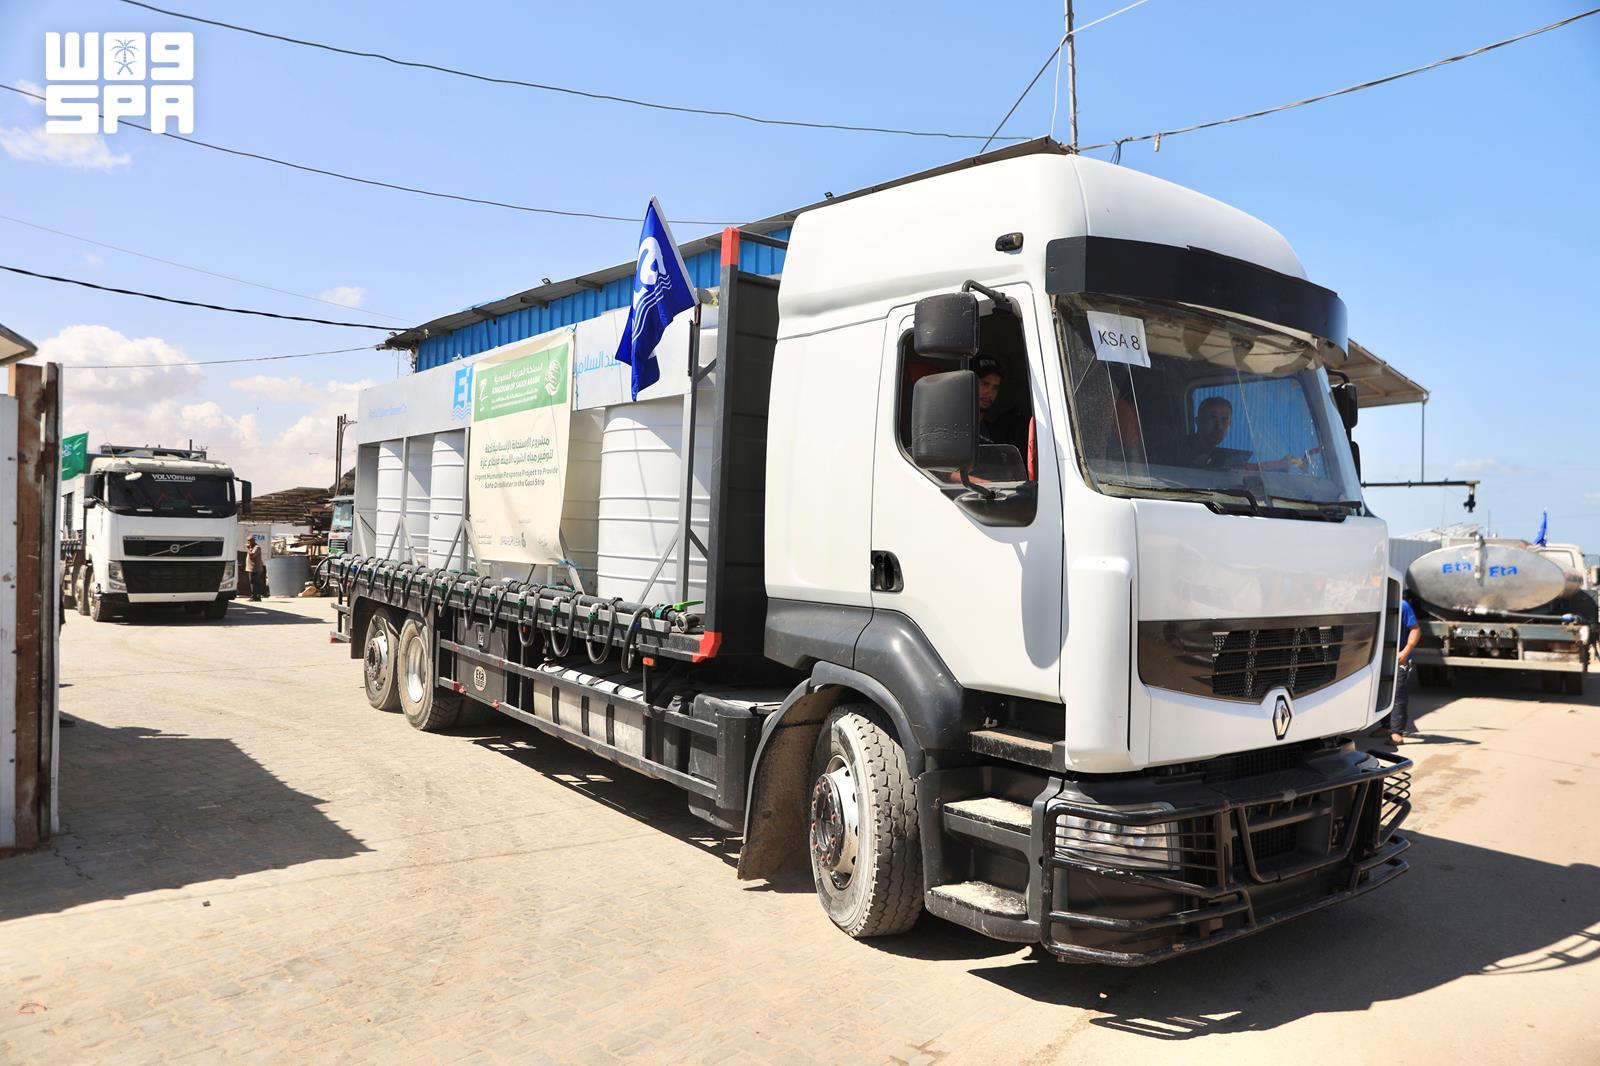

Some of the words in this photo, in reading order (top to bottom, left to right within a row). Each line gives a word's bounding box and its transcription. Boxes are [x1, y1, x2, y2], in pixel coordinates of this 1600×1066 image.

[1098, 330, 1129, 348] KSA
[1131, 335, 1141, 350] 8
[1442, 561, 1472, 574] Eta
[1489, 565, 1518, 577] Eta
